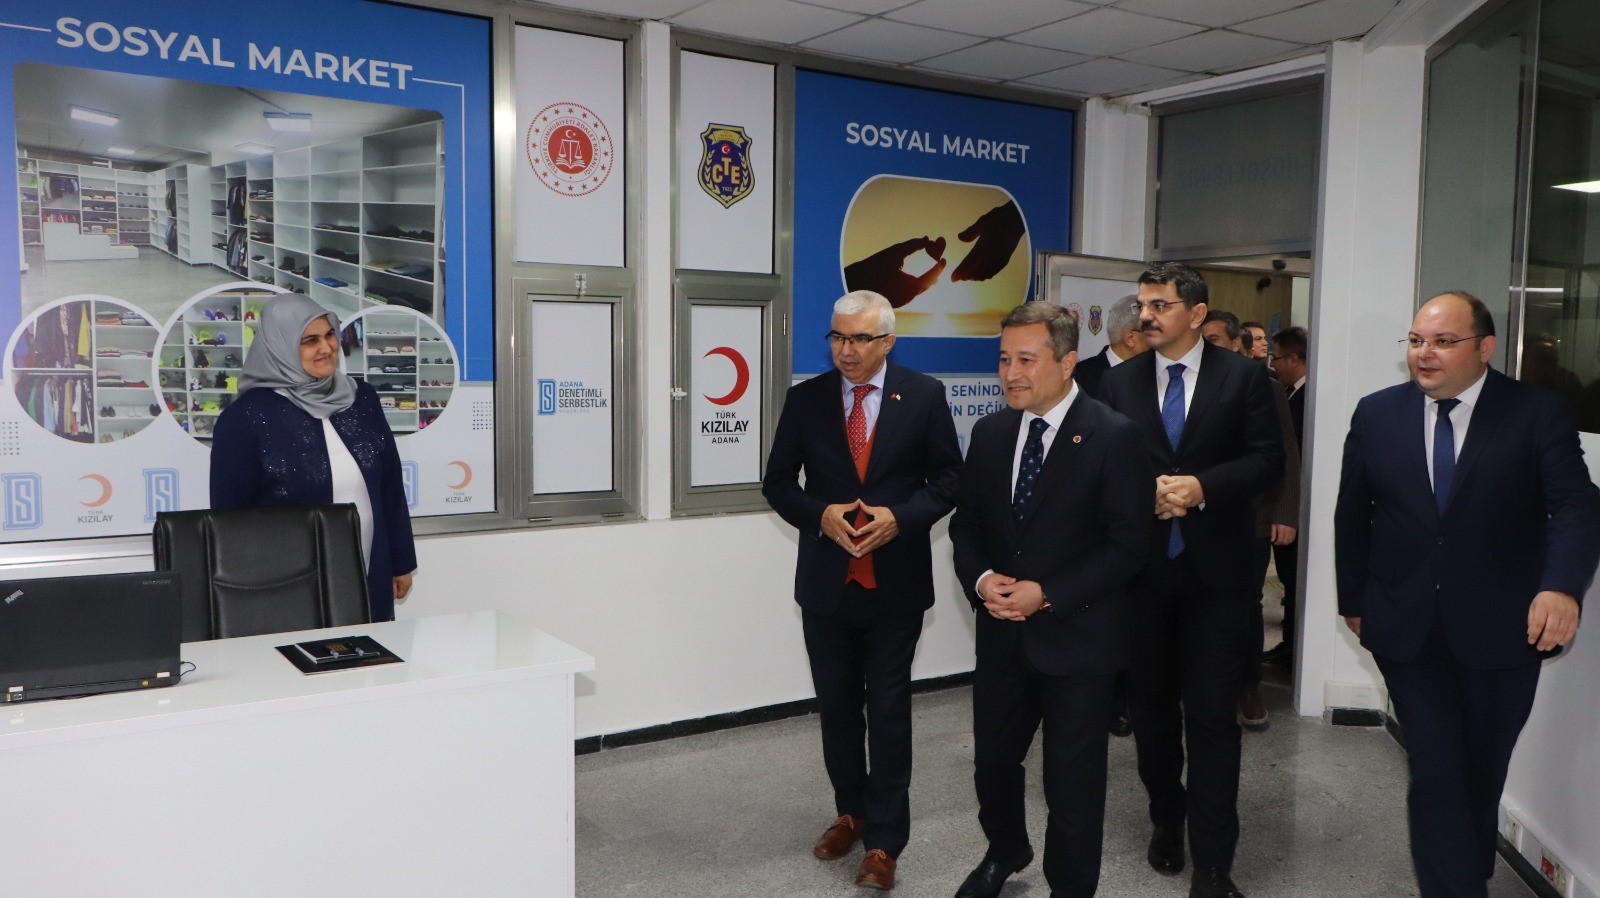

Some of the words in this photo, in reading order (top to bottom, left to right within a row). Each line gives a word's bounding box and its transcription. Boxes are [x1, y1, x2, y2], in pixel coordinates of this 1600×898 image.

[55, 16, 236, 69] SOSYAL
[248, 42, 413, 91] MARKET
[576, 121, 596, 142] ADALET
[846, 122, 937, 154] SOSYAL
[943, 134, 1030, 164] MARKET
[716, 410, 737, 419] TÜRK
[701, 420, 749, 433] KIZILAY
[711, 436, 740, 444] ADANA
[78, 515, 114, 523] KIZILAY
